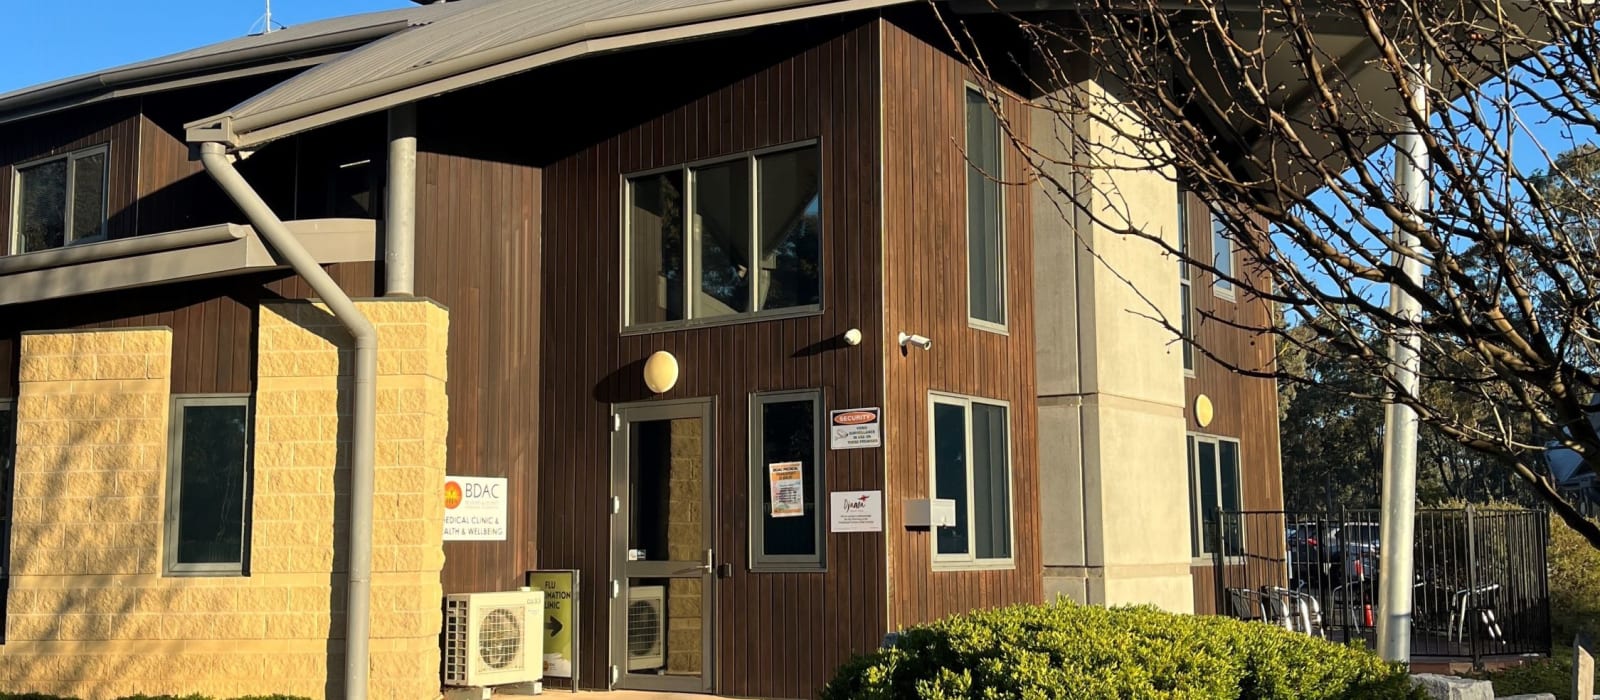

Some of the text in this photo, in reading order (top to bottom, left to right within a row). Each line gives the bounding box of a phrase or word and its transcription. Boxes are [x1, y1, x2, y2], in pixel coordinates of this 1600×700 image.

[839, 414, 871, 422] SECURITY
[465, 482, 501, 499] BDAC
[444, 516, 470, 524] EDICAL
[471, 516, 494, 524] CLINIC
[444, 527, 503, 536] ALTH & WELLBEING
[545, 580, 556, 589] FLU
[544, 601, 560, 610] LINIC
